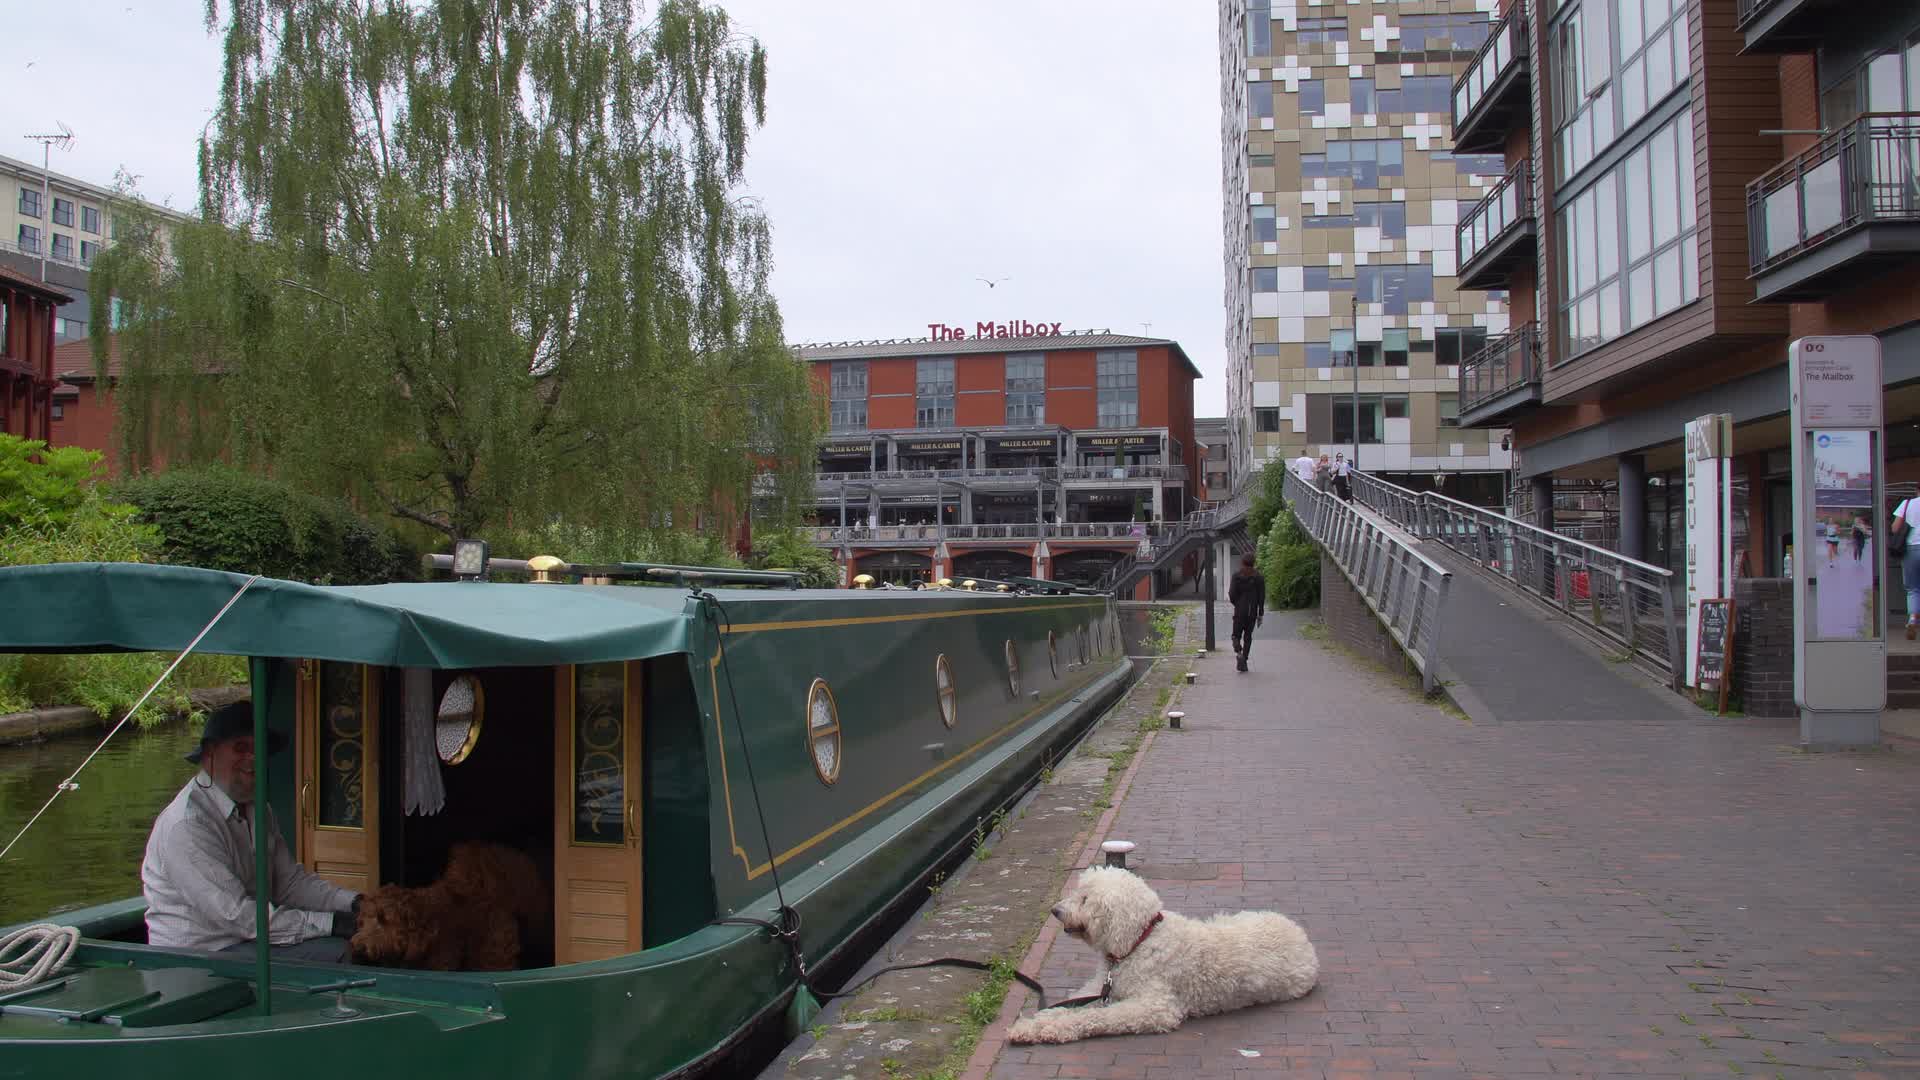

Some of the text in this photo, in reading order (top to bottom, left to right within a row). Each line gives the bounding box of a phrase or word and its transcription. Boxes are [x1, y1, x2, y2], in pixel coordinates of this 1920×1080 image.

[928, 319, 1062, 341] The Mailbox
[1806, 371, 1855, 382] The Mailbox
[1027, 439, 1051, 447] CARTER
[1686, 431, 1697, 617] THE CUBE
